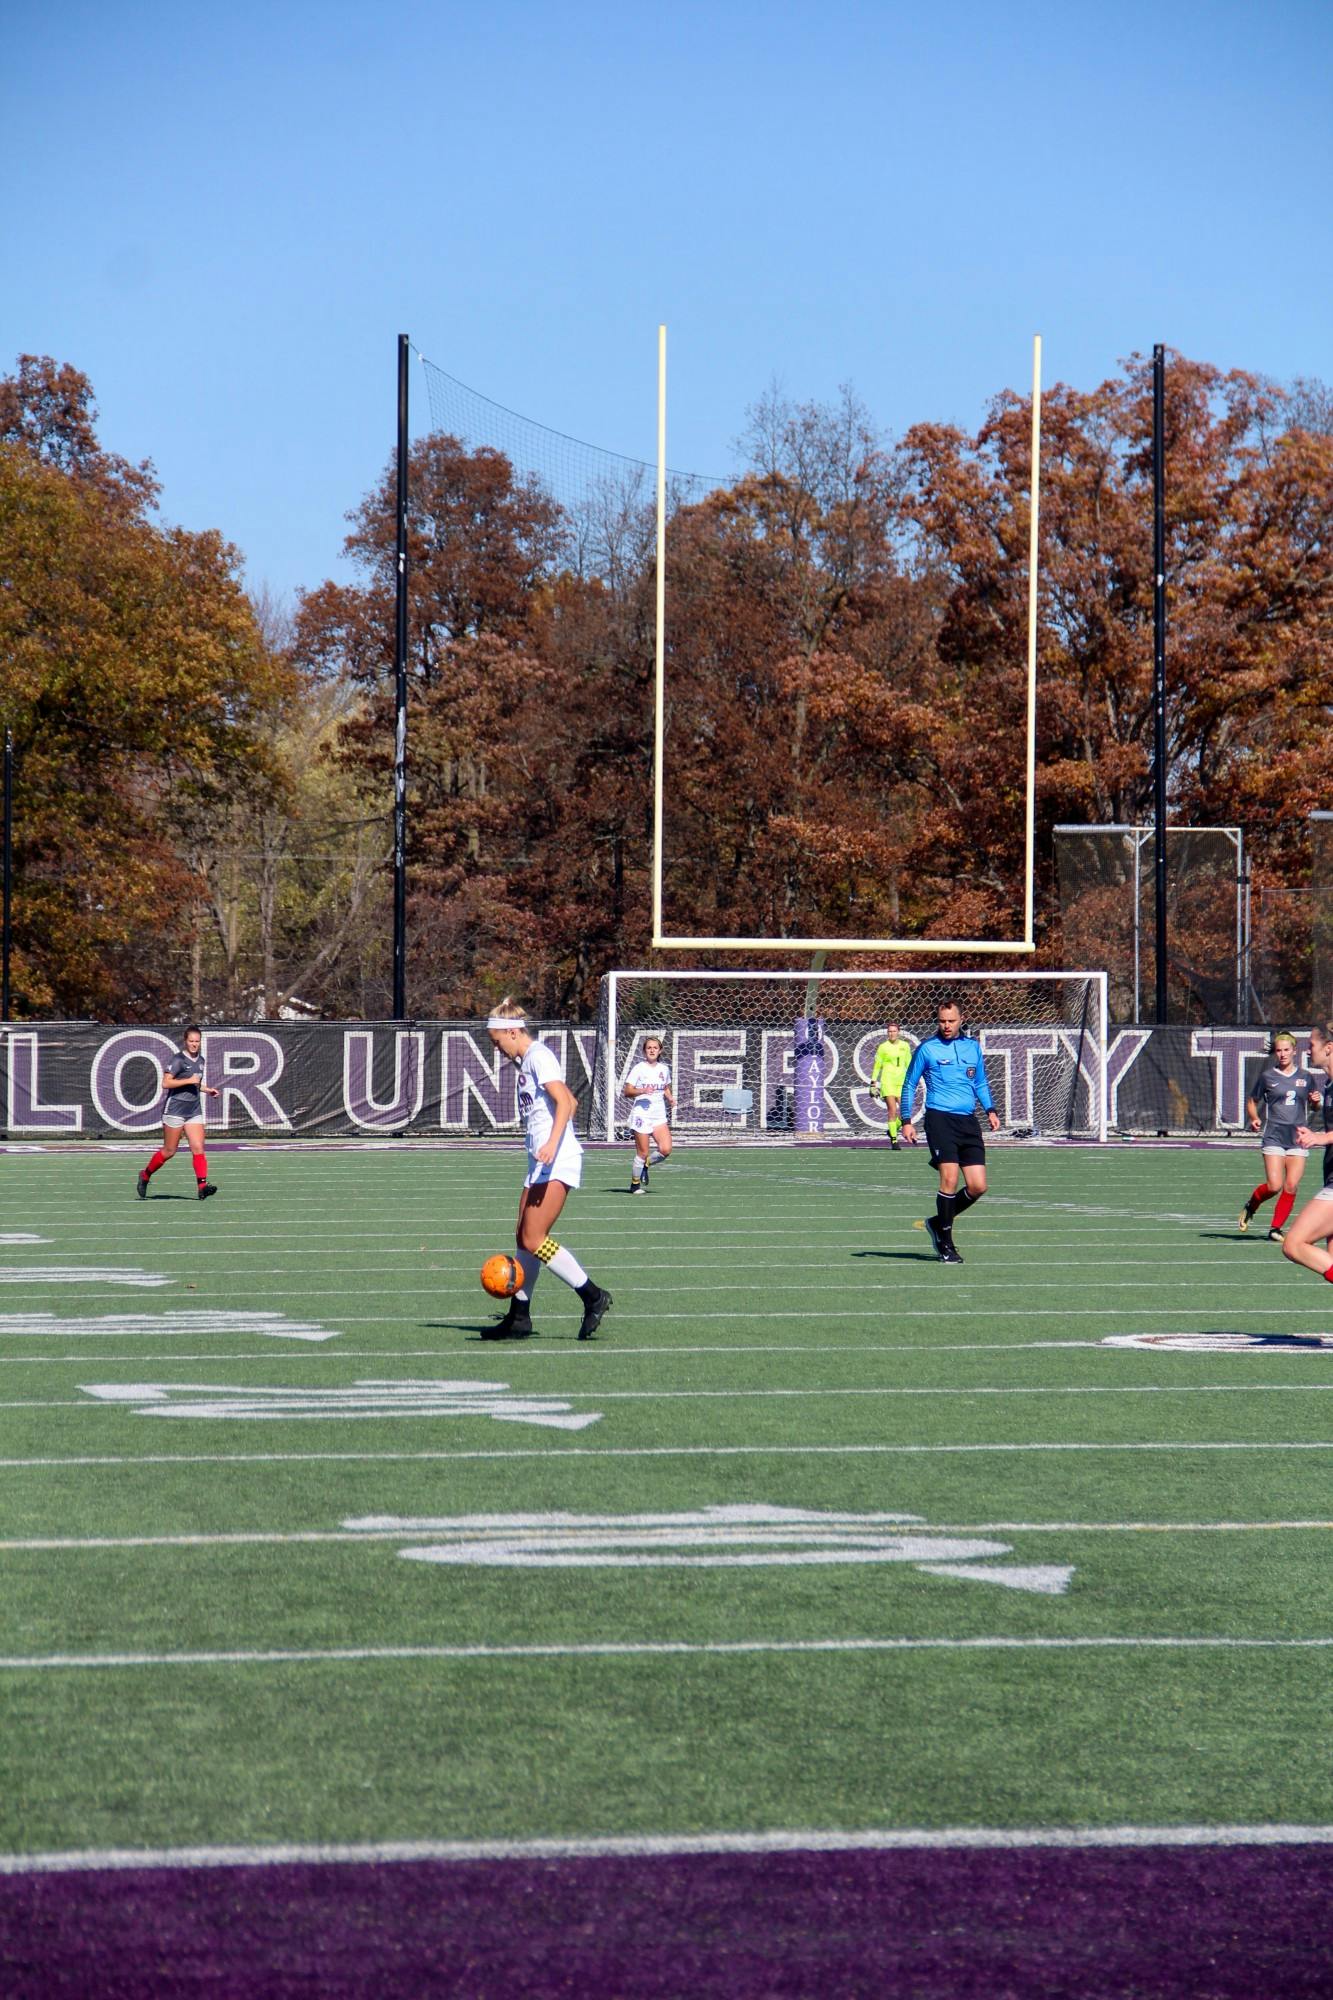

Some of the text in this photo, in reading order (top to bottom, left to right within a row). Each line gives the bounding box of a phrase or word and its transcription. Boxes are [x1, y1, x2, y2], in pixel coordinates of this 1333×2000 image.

[8, 1030, 292, 1131] LOR
[343, 1028, 1152, 1131] UNVERSTY
[808, 1055, 820, 1132] AYLOR
[1285, 1090, 1296, 1105] 2
